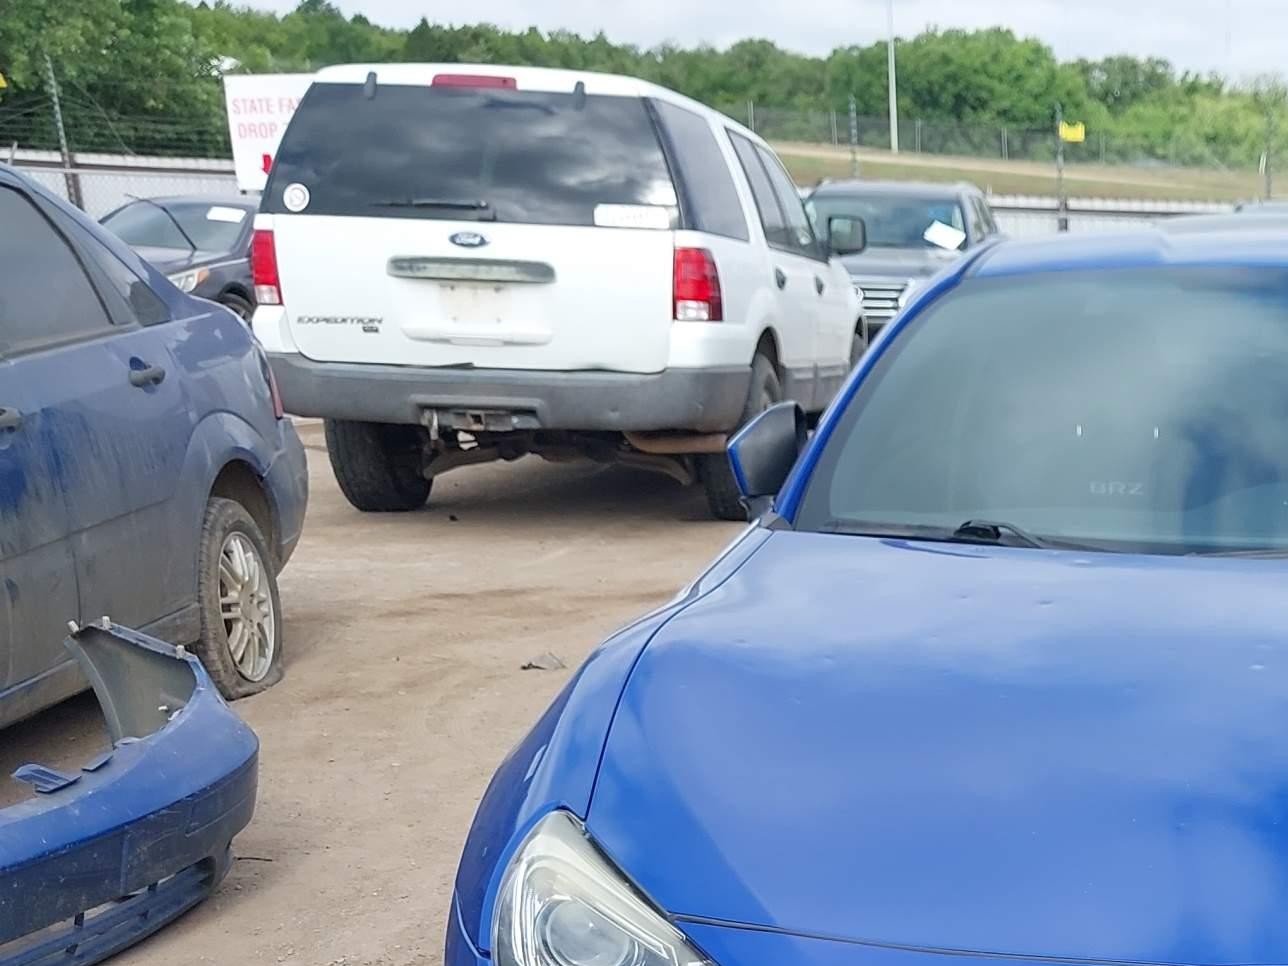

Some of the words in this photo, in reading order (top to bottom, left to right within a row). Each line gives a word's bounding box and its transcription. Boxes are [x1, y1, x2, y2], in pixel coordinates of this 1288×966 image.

[232, 98, 273, 115] STATE
[238, 122, 278, 139] DROP
[296, 315, 384, 324] EXPEDITION
[1089, 480, 1145, 496] BRZ
